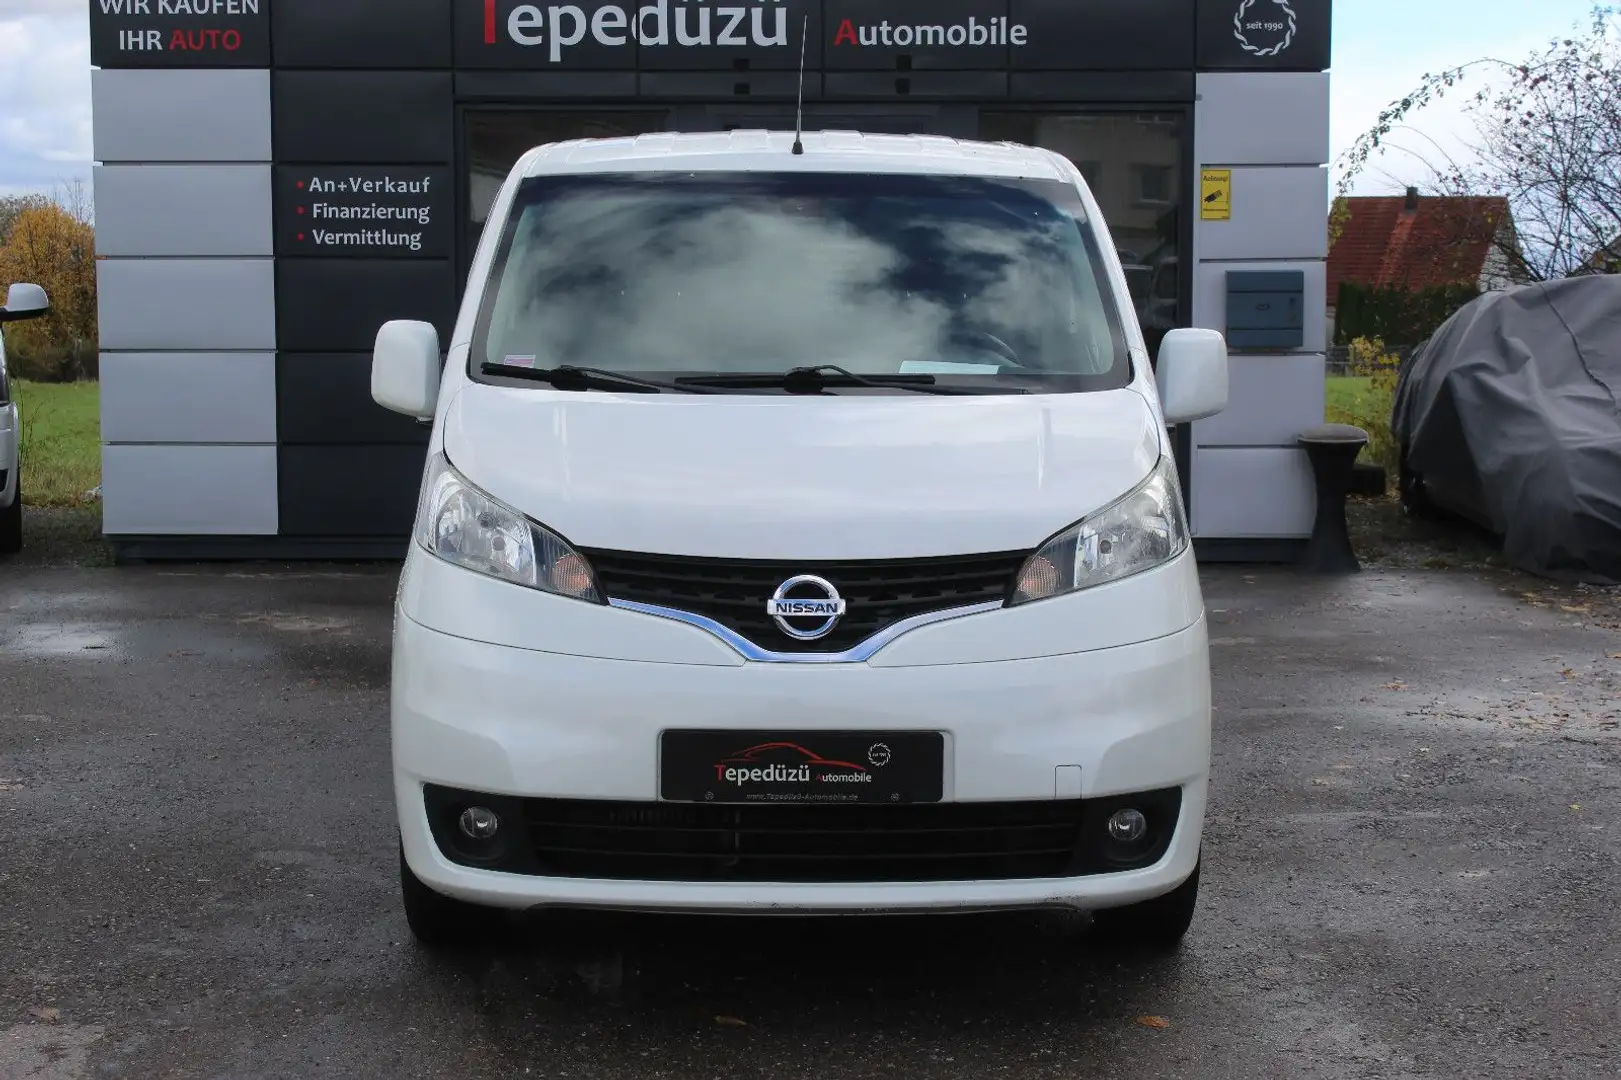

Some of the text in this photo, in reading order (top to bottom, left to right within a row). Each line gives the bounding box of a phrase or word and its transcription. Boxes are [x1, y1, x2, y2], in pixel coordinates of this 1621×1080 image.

[100, 0, 259, 14] WIR KAUFEN
[834, 17, 1028, 46] Automobile
[1246, 21, 1283, 31] seit 1990
[119, 29, 242, 50] IHR AUTO
[309, 176, 430, 193] An+Verkauf
[312, 202, 430, 225] Finanzierung
[312, 229, 421, 251] Vermittlung
[776, 602, 838, 613] NISSAN
[714, 764, 872, 786] Tepedüzü Automobile
